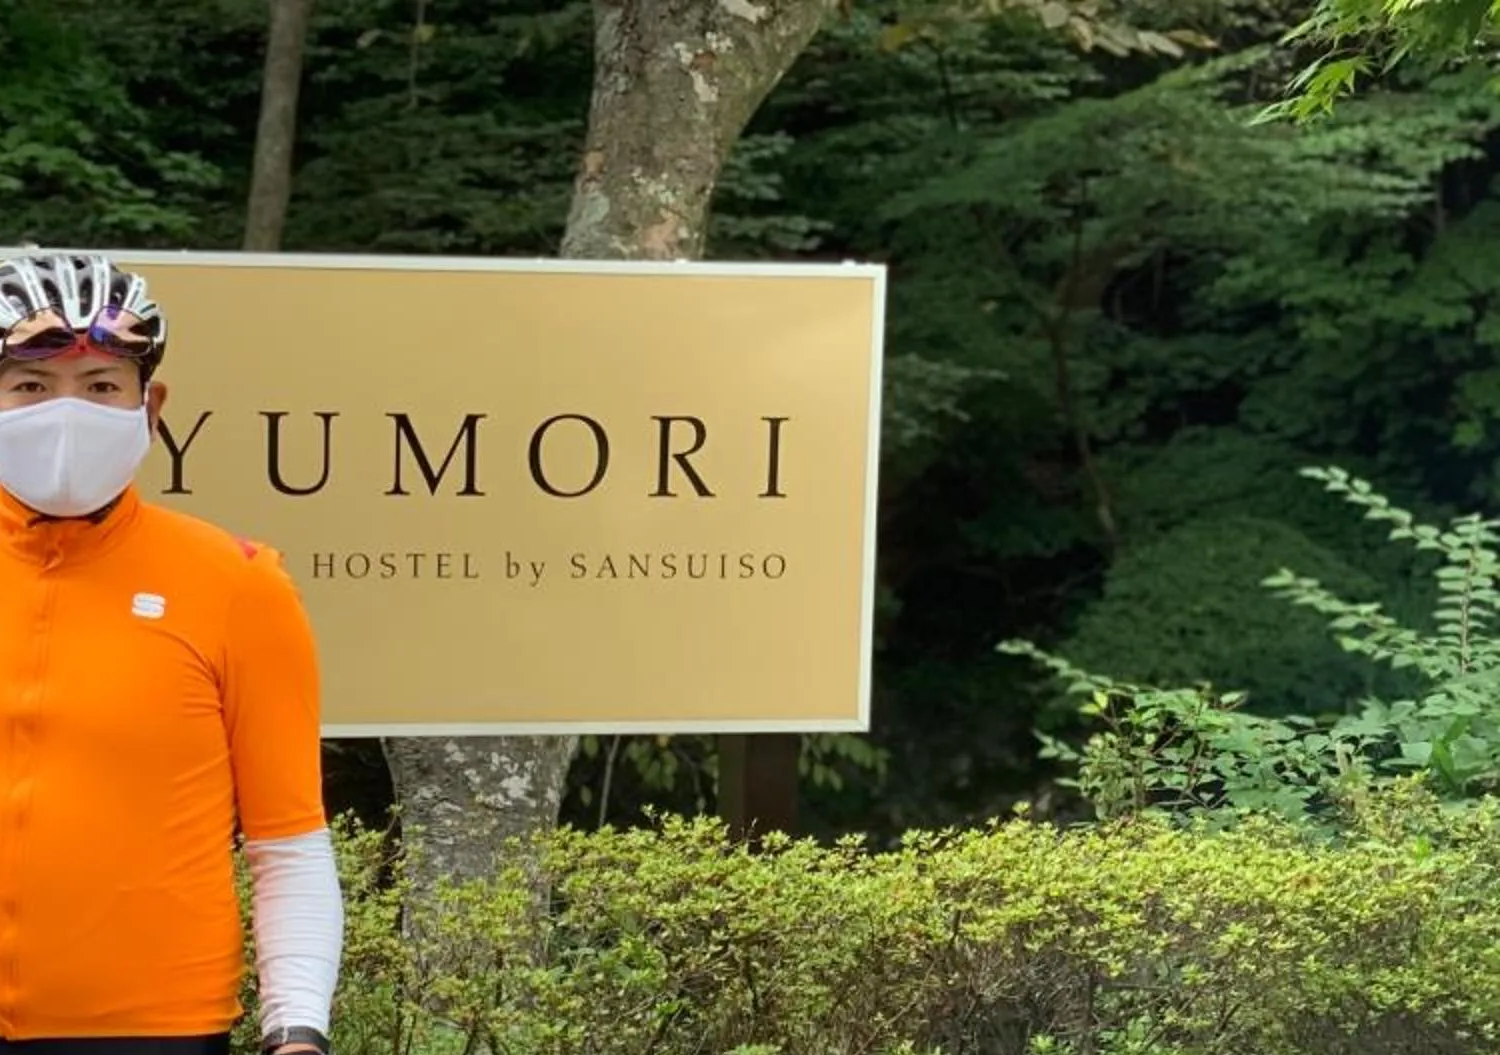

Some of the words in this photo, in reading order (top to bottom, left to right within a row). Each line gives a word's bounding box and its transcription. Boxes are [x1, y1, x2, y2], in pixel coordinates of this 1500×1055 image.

[156, 410, 790, 498] YUMORI
[312, 552, 480, 580] HOSTEL
[504, 552, 547, 587] by
[570, 552, 787, 580] SANSUISO
